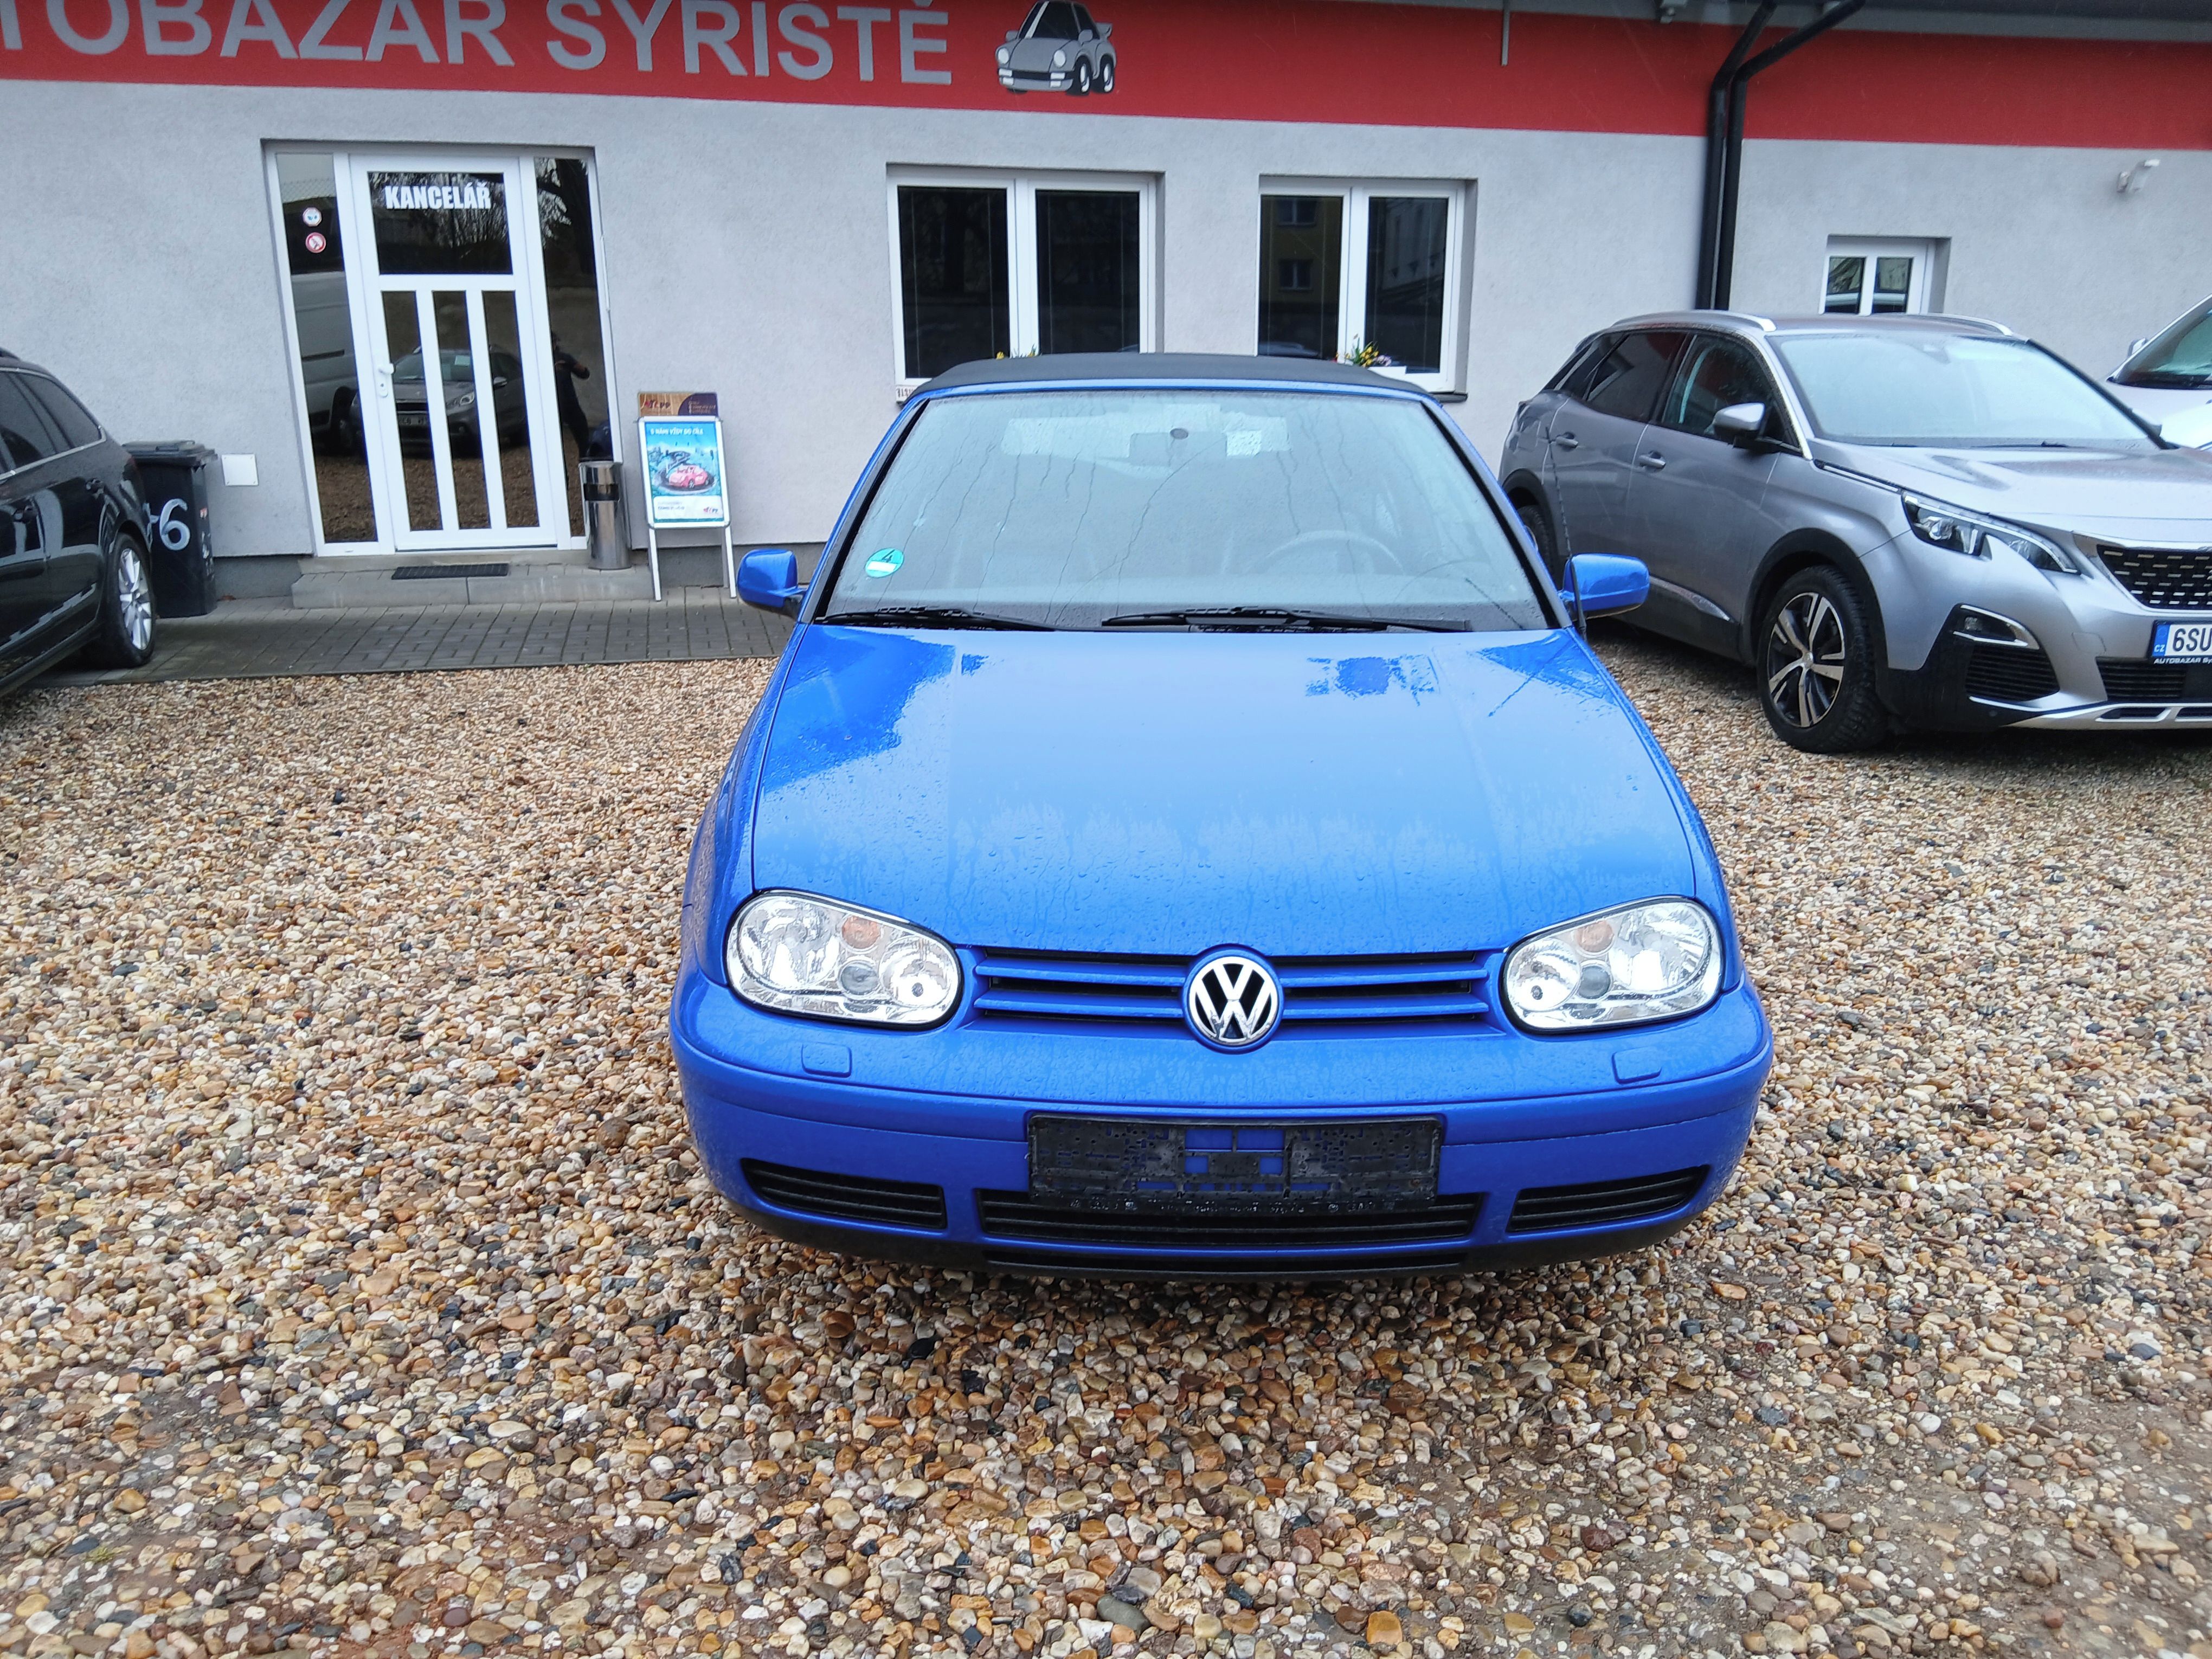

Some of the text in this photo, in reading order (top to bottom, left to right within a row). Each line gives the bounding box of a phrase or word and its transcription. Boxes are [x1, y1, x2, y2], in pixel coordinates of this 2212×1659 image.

[385, 182, 491, 209] KANCELÁŘ
[881, 549, 895, 563] 4
[1189, 956, 1278, 1046] VW
